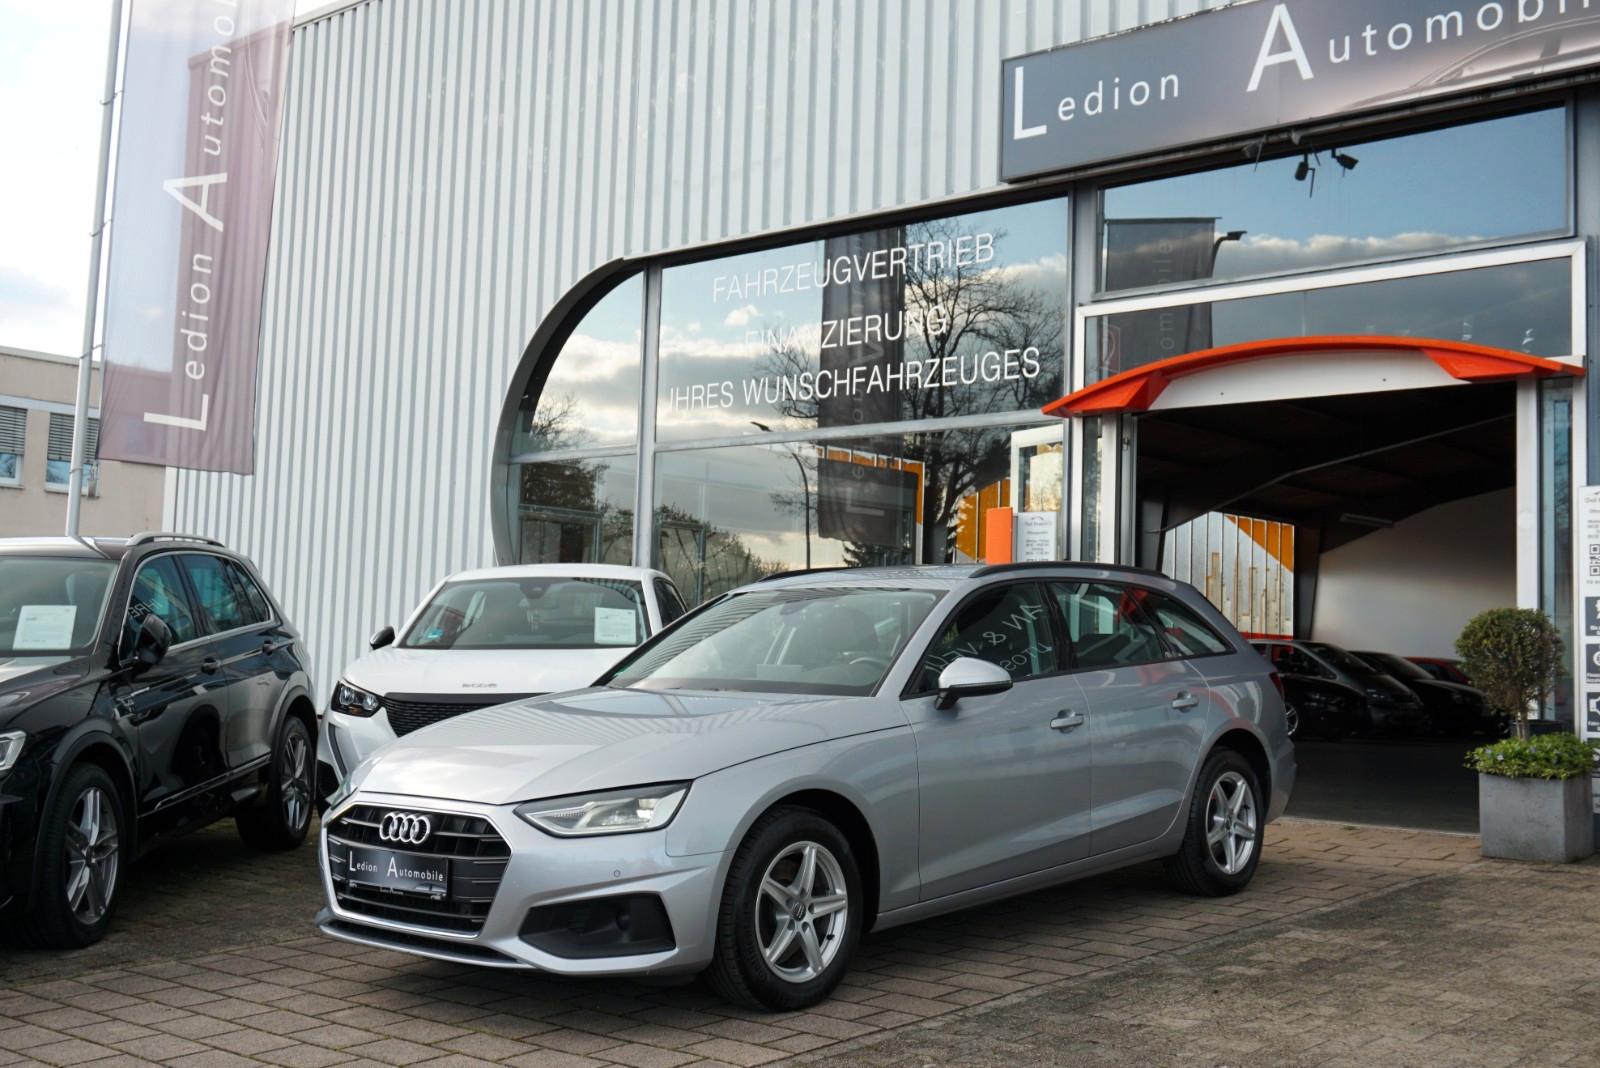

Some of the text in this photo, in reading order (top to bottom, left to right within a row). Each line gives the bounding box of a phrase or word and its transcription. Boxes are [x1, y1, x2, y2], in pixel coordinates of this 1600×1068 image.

[1013, 66, 1180, 140] Ledion
[143, 0, 238, 432] Ledion Automo
[712, 232, 995, 304] FAHRZEUGVERTRIEB
[744, 304, 948, 357] FINANZIERUNG
[669, 346, 1041, 413] IHRES WUNSCHFAHRZEUGES
[349, 850, 444, 882] Ledion Automobile
